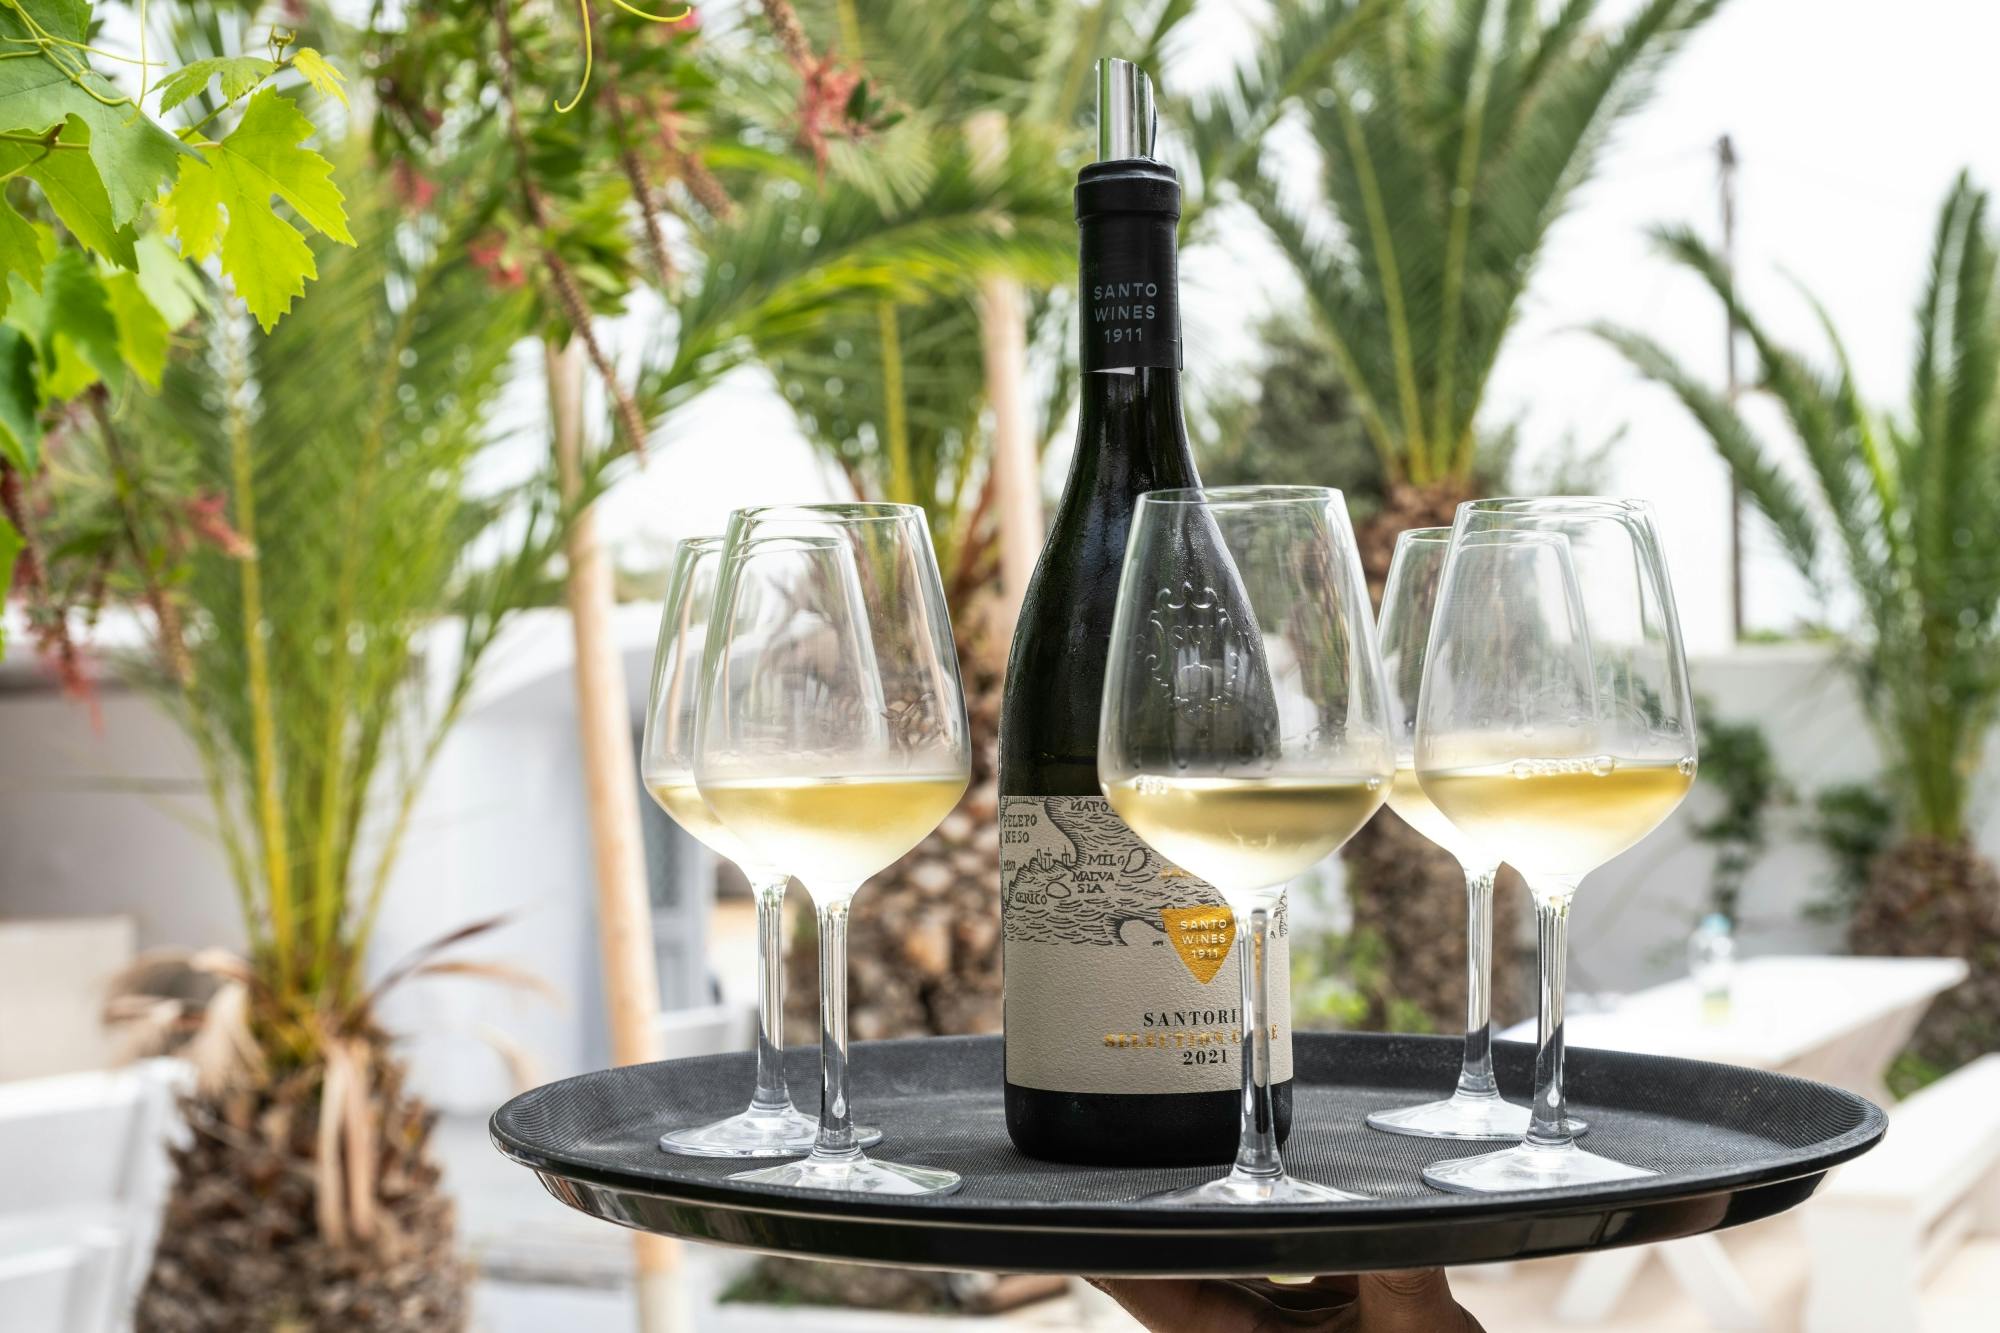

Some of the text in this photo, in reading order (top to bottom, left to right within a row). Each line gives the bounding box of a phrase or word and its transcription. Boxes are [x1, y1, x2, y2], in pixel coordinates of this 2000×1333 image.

[1094, 282, 1157, 300] SANTO
[1094, 305, 1155, 322] WINES
[1104, 327, 1142, 343] 1911
[1070, 801, 1109, 812] NAPO
[1005, 831, 1030, 844] NESO
[1077, 883, 1106, 894] SIA
[1180, 918, 1227, 930] SANTO
[1181, 933, 1226, 945] WINES
[1191, 949, 1218, 959] 1911
[1143, 1008, 1242, 1027] SANTORI
[1183, 1049, 1227, 1065] 2021
